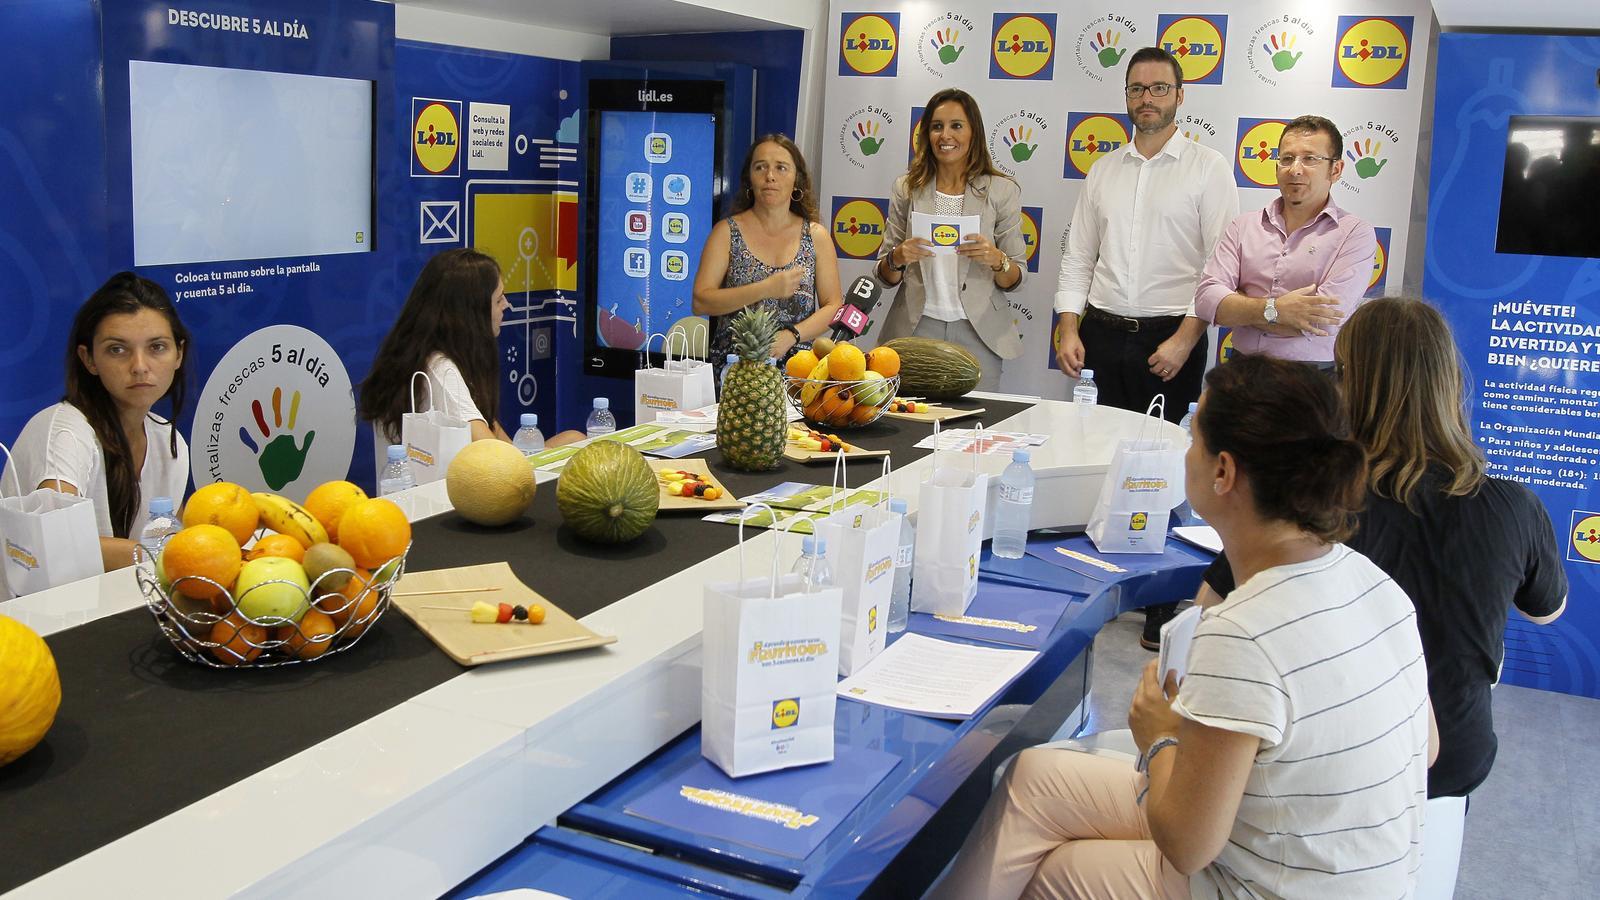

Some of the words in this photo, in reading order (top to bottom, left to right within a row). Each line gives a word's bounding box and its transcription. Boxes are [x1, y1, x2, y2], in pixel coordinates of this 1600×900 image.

[168, 8, 249, 33] DESCUBRE
[252, 20, 260, 34] 5
[263, 21, 281, 37] AL
[283, 19, 309, 39] DÍA
[946, 12, 952, 20] 5
[954, 14, 962, 22] al
[962, 18, 974, 31] día
[1124, 20, 1137, 33] día
[1282, 14, 1289, 22] 5
[1300, 22, 1314, 35] día
[637, 89, 673, 102] lidl.es
[473, 115, 499, 124] Consulta
[499, 116, 505, 124] la
[882, 112, 892, 124] día
[1027, 112, 1036, 120] al
[1035, 116, 1048, 130] día
[1186, 115, 1192, 123] 5
[1194, 118, 1204, 126] al
[1203, 122, 1216, 136] día
[472, 126, 484, 134] web
[489, 128, 504, 136] redes
[1367, 122, 1373, 130] 5
[1375, 124, 1386, 132] al
[1385, 128, 1399, 143] día
[472, 138, 495, 147] sociales
[496, 139, 503, 147] de
[175, 272, 209, 284] Coloca
[210, 271, 221, 281] tu
[223, 269, 248, 280] mano
[250, 264, 274, 278] sobre
[276, 264, 284, 276] la
[286, 262, 320, 277] pantalla
[175, 290, 182, 302] y
[184, 286, 217, 299] cuenta
[218, 284, 225, 295] 5
[226, 284, 236, 294] al
[237, 282, 254, 294] día.
[1021, 308, 1032, 320] día
[1492, 300, 1576, 318] ¡MUÉVETE!
[1491, 318, 1511, 331] LA
[1490, 336, 1578, 354] DIVERTIDA
[1582, 342, 1592, 354] Y
[1488, 353, 1526, 367] BIEN
[218, 357, 265, 406] frescas
[271, 344, 282, 364] 5
[287, 348, 305, 366] al
[305, 357, 330, 388] día
[1484, 380, 1496, 388] La
[1498, 382, 1546, 392] actividad
[1549, 384, 1577, 395] física
[1483, 392, 1510, 400] como
[1513, 394, 1557, 404] caminar,
[1560, 398, 1598, 407] montar
[1482, 401, 1508, 410] tiene
[1511, 405, 1582, 416] considerables
[1480, 421, 1491, 429] La
[1494, 422, 1561, 436] Organización
[1488, 437, 1511, 446] Para
[1514, 440, 1541, 449] niños
[1487, 449, 1534, 458] actividad
[1536, 454, 1587, 464] moderada
[1486, 462, 1508, 471] Para
[1514, 465, 1552, 475] adultos
[1558, 468, 1587, 480] (18+):
[1534, 479, 1588, 490] moderada.
